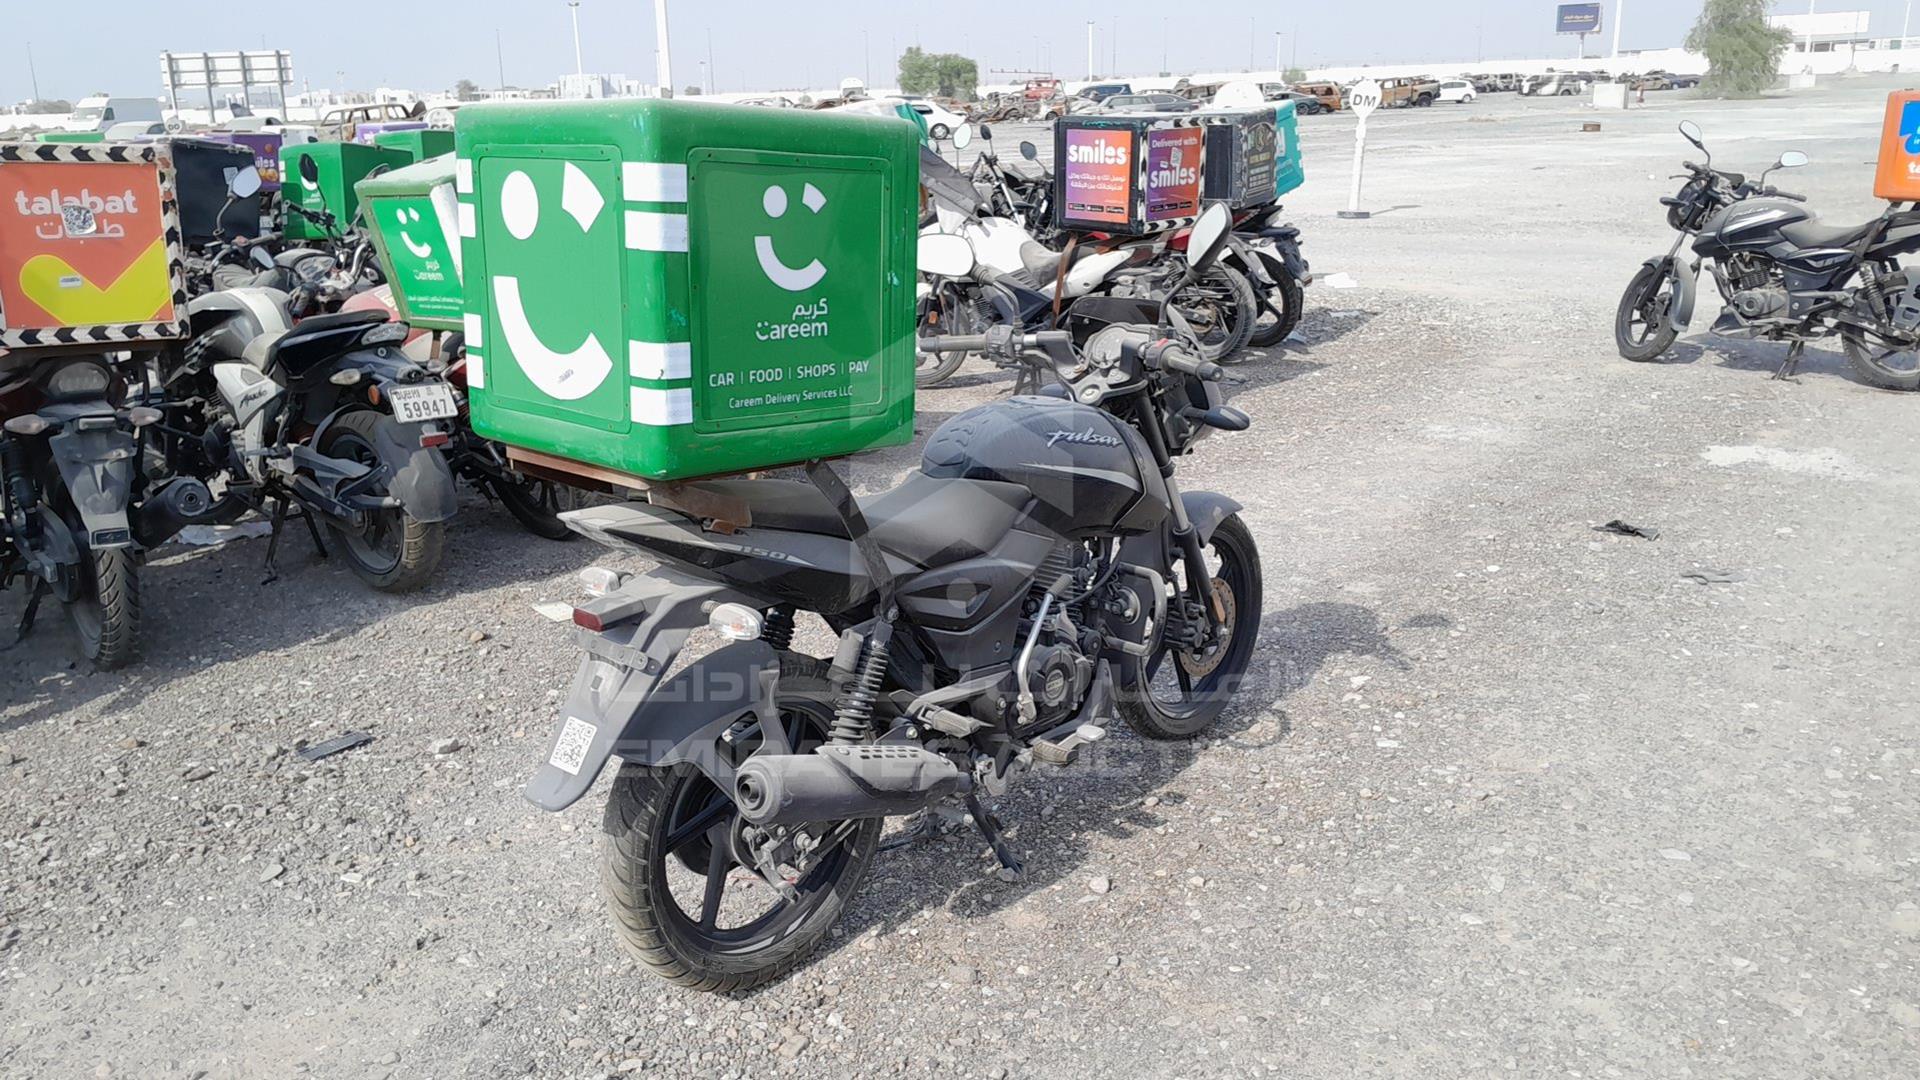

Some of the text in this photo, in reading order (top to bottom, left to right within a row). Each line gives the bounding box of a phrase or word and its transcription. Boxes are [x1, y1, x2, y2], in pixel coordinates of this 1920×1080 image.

[1353, 94, 1377, 107] DM
[1068, 139, 1127, 165] smiles
[1150, 164, 1196, 189] smiles
[15, 189, 138, 215] talabat
[792, 298, 828, 321] كريم
[755, 321, 828, 341] Careem
[709, 360, 869, 388] CAR FOOD SHOPS PAY
[403, 398, 448, 419] 59947
[729, 384, 854, 409] Careem Delivery Services LLC
[743, 546, 787, 560] 150
